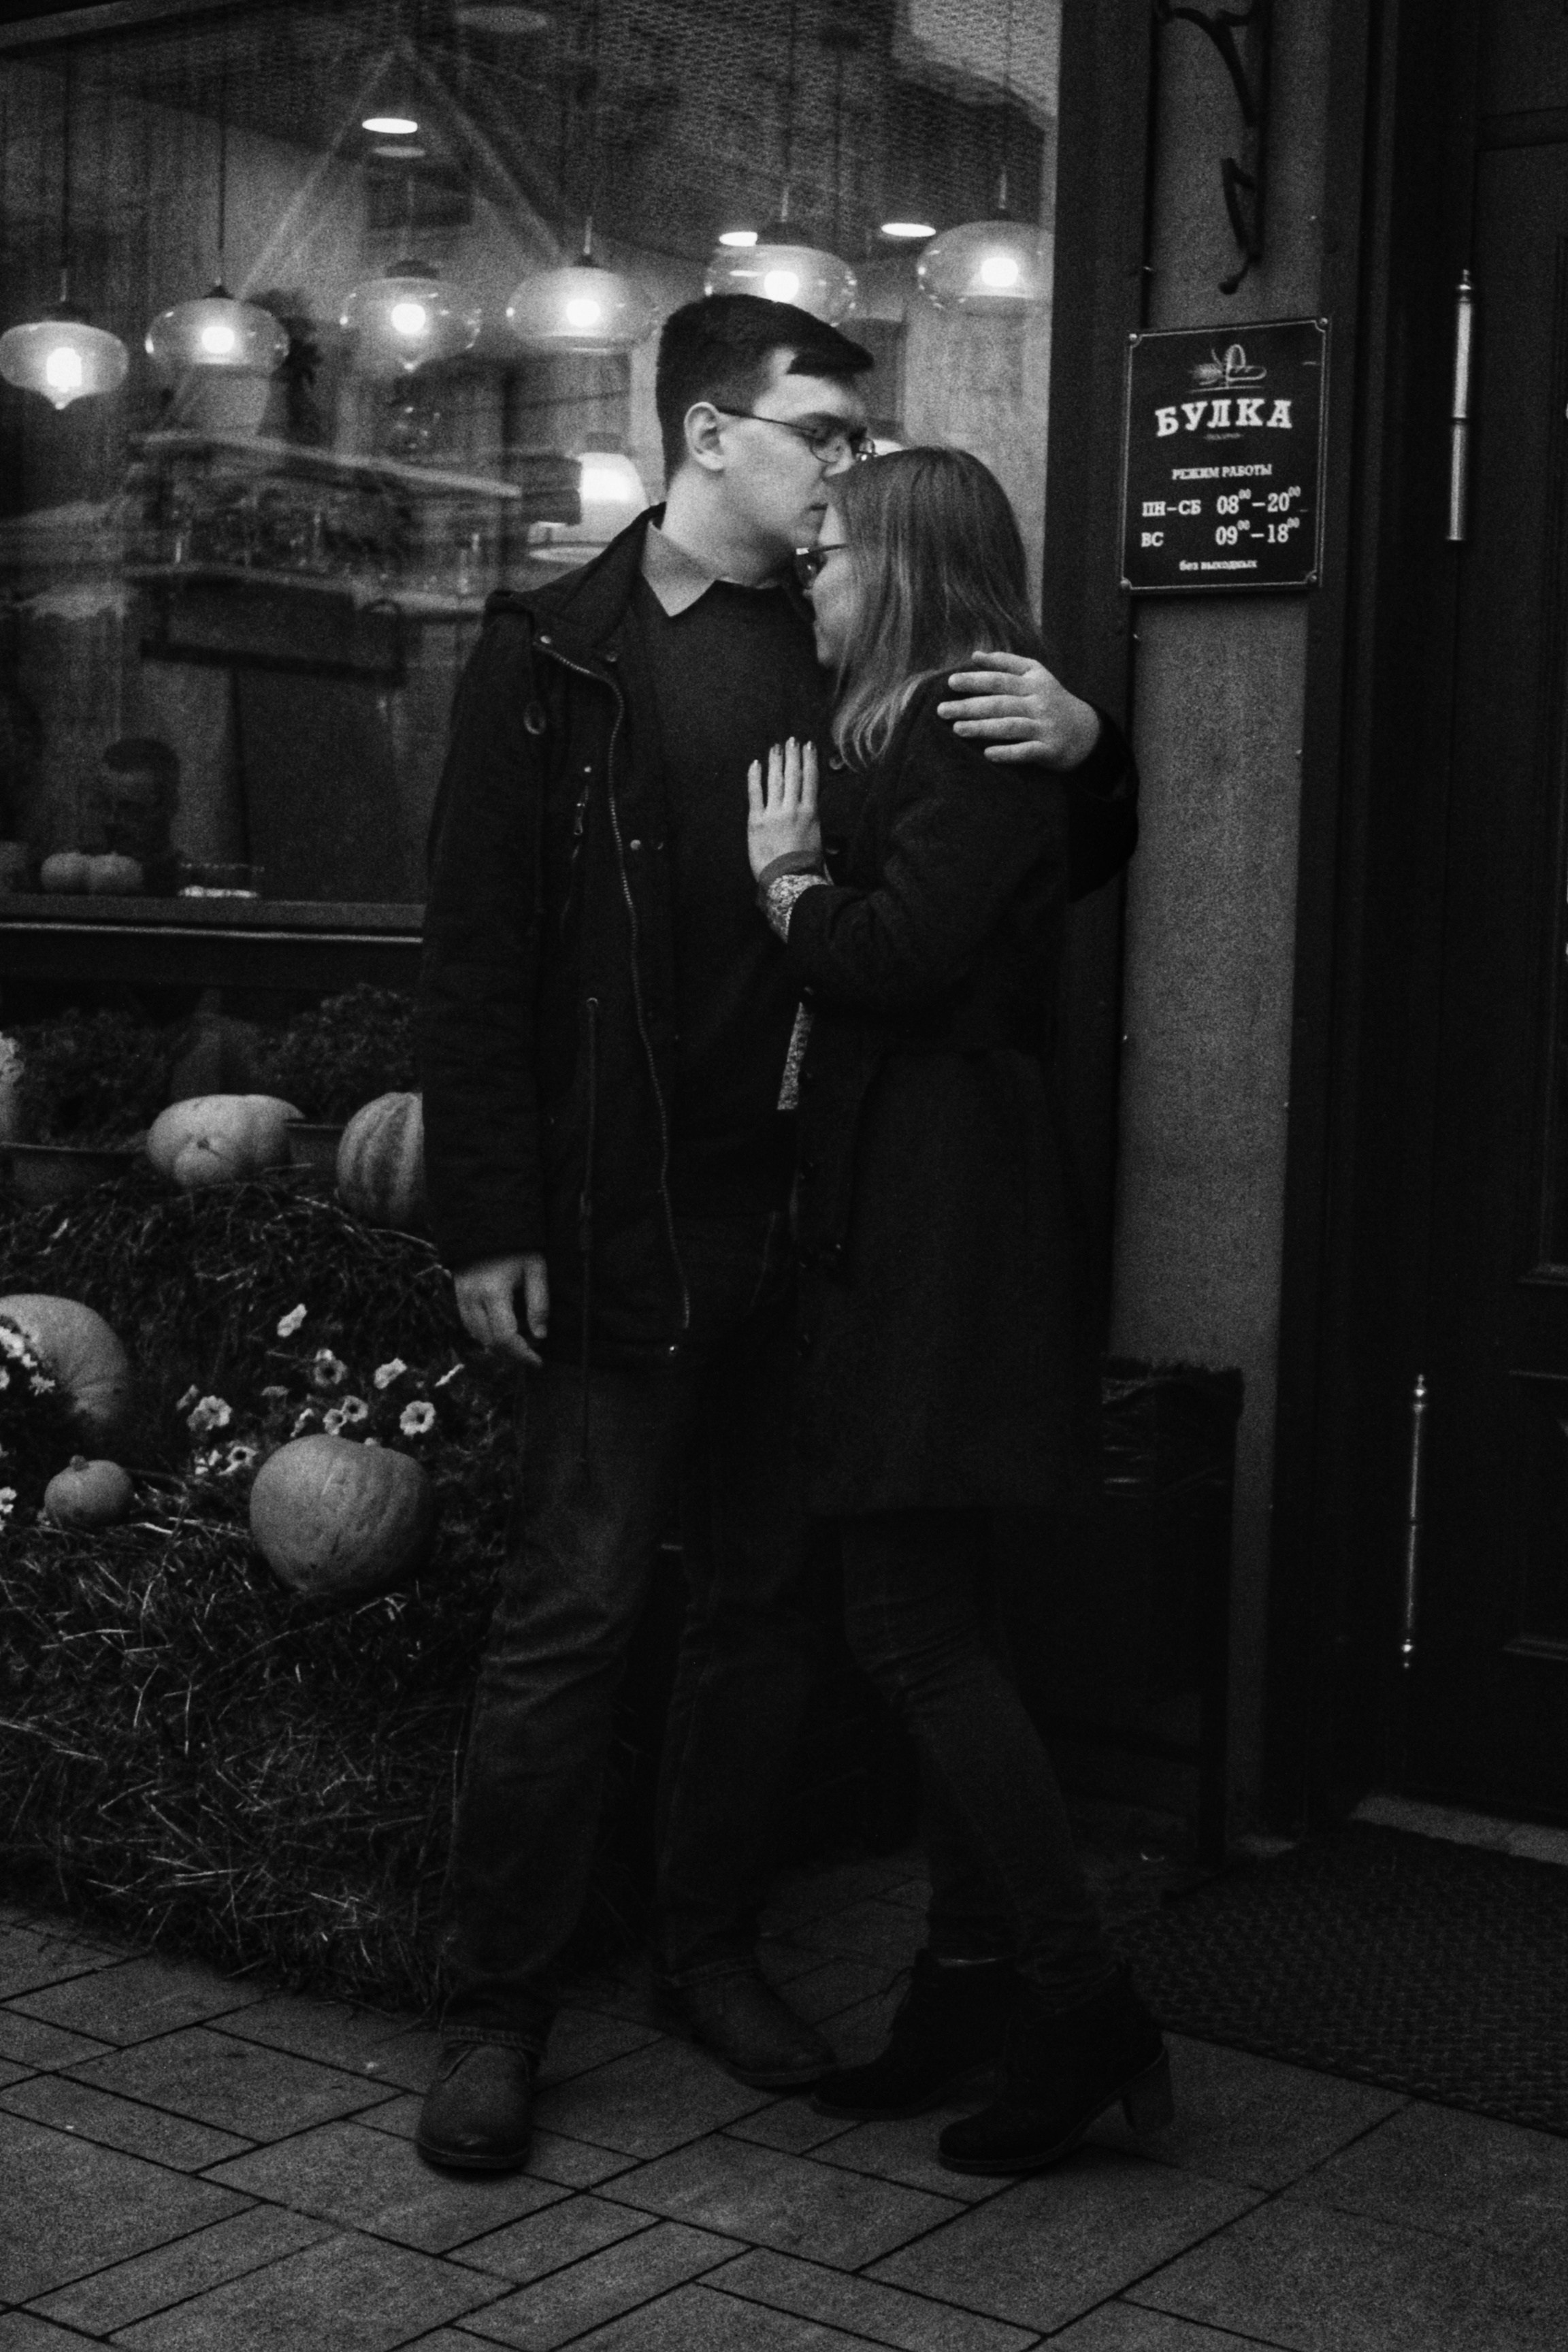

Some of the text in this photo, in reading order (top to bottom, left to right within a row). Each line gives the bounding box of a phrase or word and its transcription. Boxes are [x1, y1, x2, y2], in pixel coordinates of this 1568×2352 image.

[1155, 398, 1292, 437] БУЛКА
[1172, 463, 1273, 480] РЕЖИМ РАБОТЫ
[1141, 532, 1164, 547] ВС
